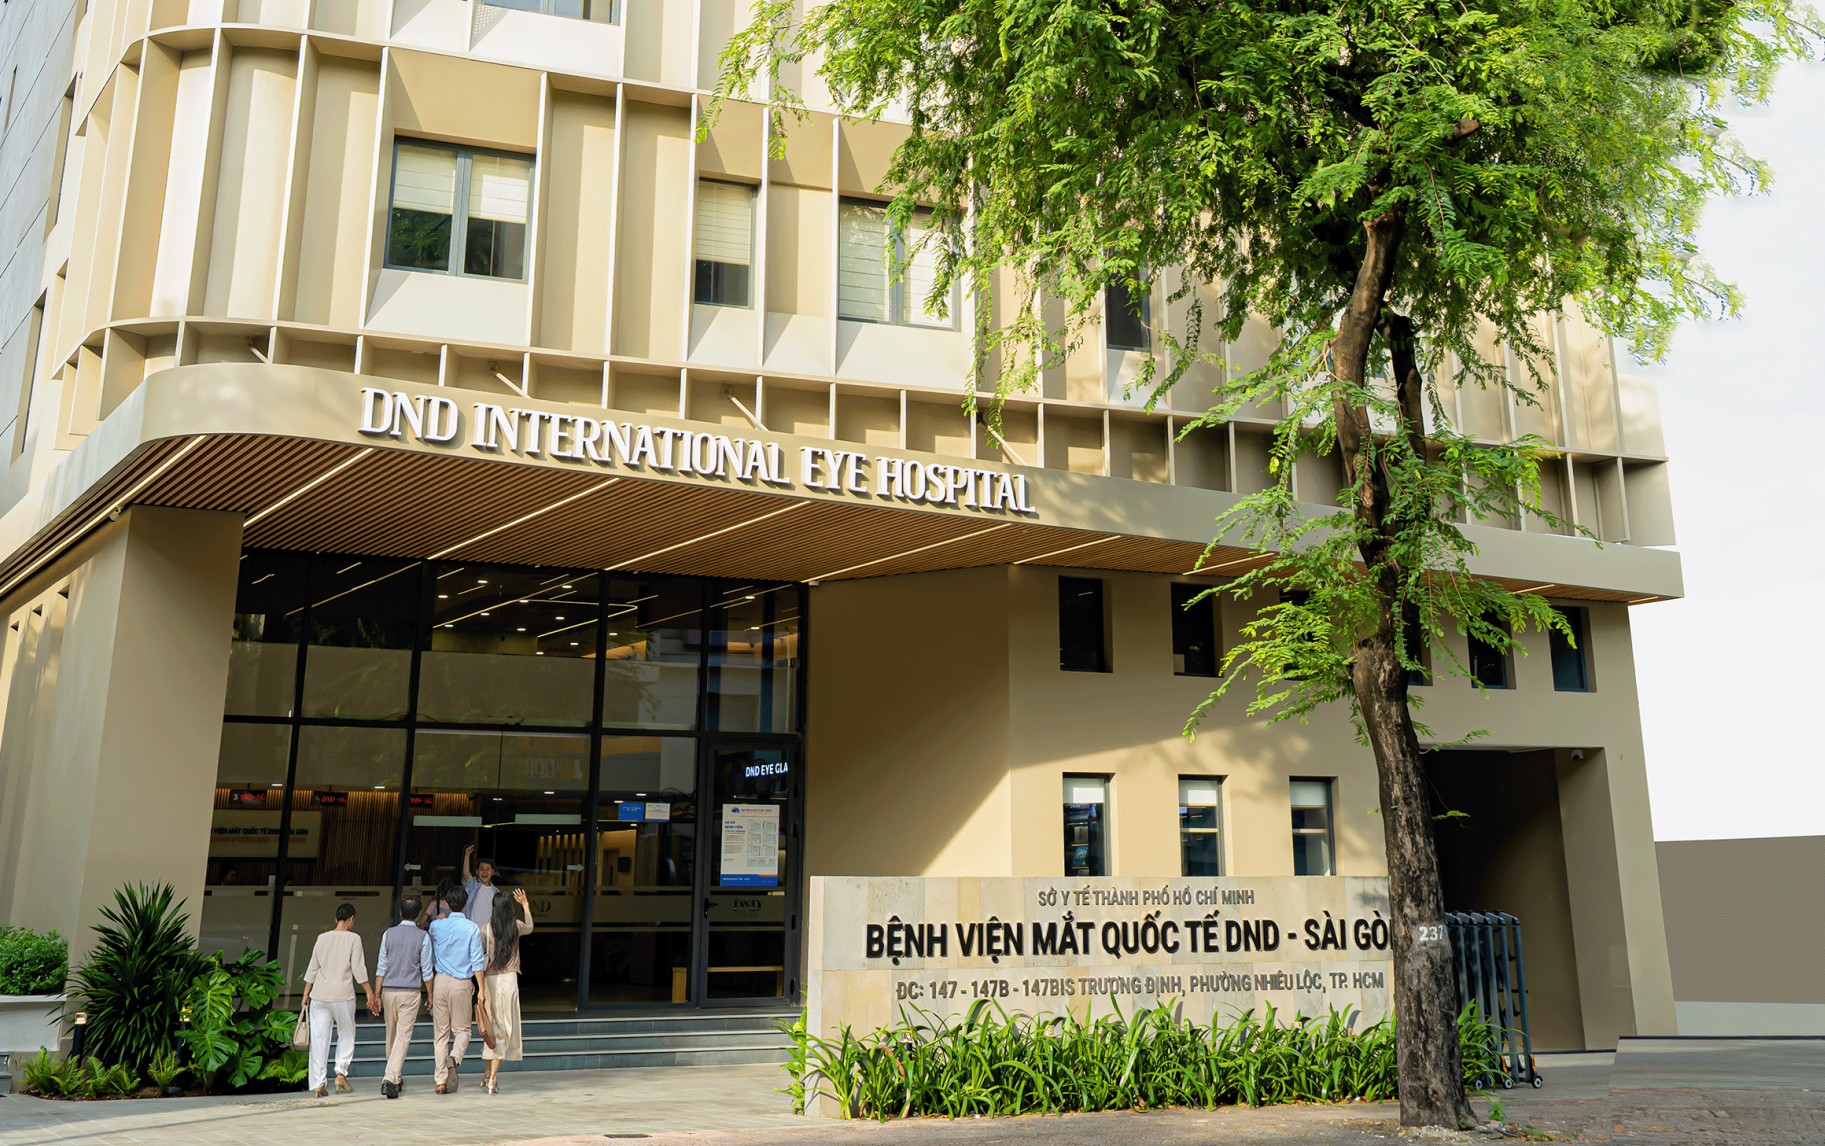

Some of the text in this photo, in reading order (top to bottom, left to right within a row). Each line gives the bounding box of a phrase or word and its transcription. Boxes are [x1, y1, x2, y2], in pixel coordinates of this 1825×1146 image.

[358, 387, 1036, 513] DND INTERNATIONAL EYE HOSPITAL
[745, 765, 760, 778] DND
[761, 763, 774, 776] EYE
[1061, 890, 1071, 906] Y
[1073, 885, 1090, 906] TẾ
[1093, 886, 1139, 906] THÀNH
[1143, 884, 1170, 905] PHỐ
[1173, 884, 1192, 905] HỒ
[1196, 886, 1218, 905] CHÍ
[1222, 889, 1255, 905] MINH
[866, 915, 948, 966] BỆNH
[955, 915, 1025, 964] VIỆN
[1032, 910, 1096, 957] MẮT
[1101, 910, 1179, 960] QUỐC
[1184, 910, 1220, 954] TẾ
[1225, 919, 1280, 953] DND
[1304, 910, 1347, 951] SÀI
[1354, 910, 1394, 951] GÒ
[896, 981, 925, 1000] ĐC:
[929, 980, 958, 999] 147
[971, 979, 1010, 998] 147B
[1023, 977, 1076, 997] 147BIS
[1078, 976, 1141, 995] TRƯƠNG
[1144, 976, 1186, 998] ĐỊNH,
[1189, 970, 1252, 992] PHƯỜNG
[1255, 970, 1294, 991] NHIÊU
[1296, 969, 1327, 994] LỘC,
[1329, 972, 1348, 989] TP.
[1353, 972, 1384, 989] HCM
